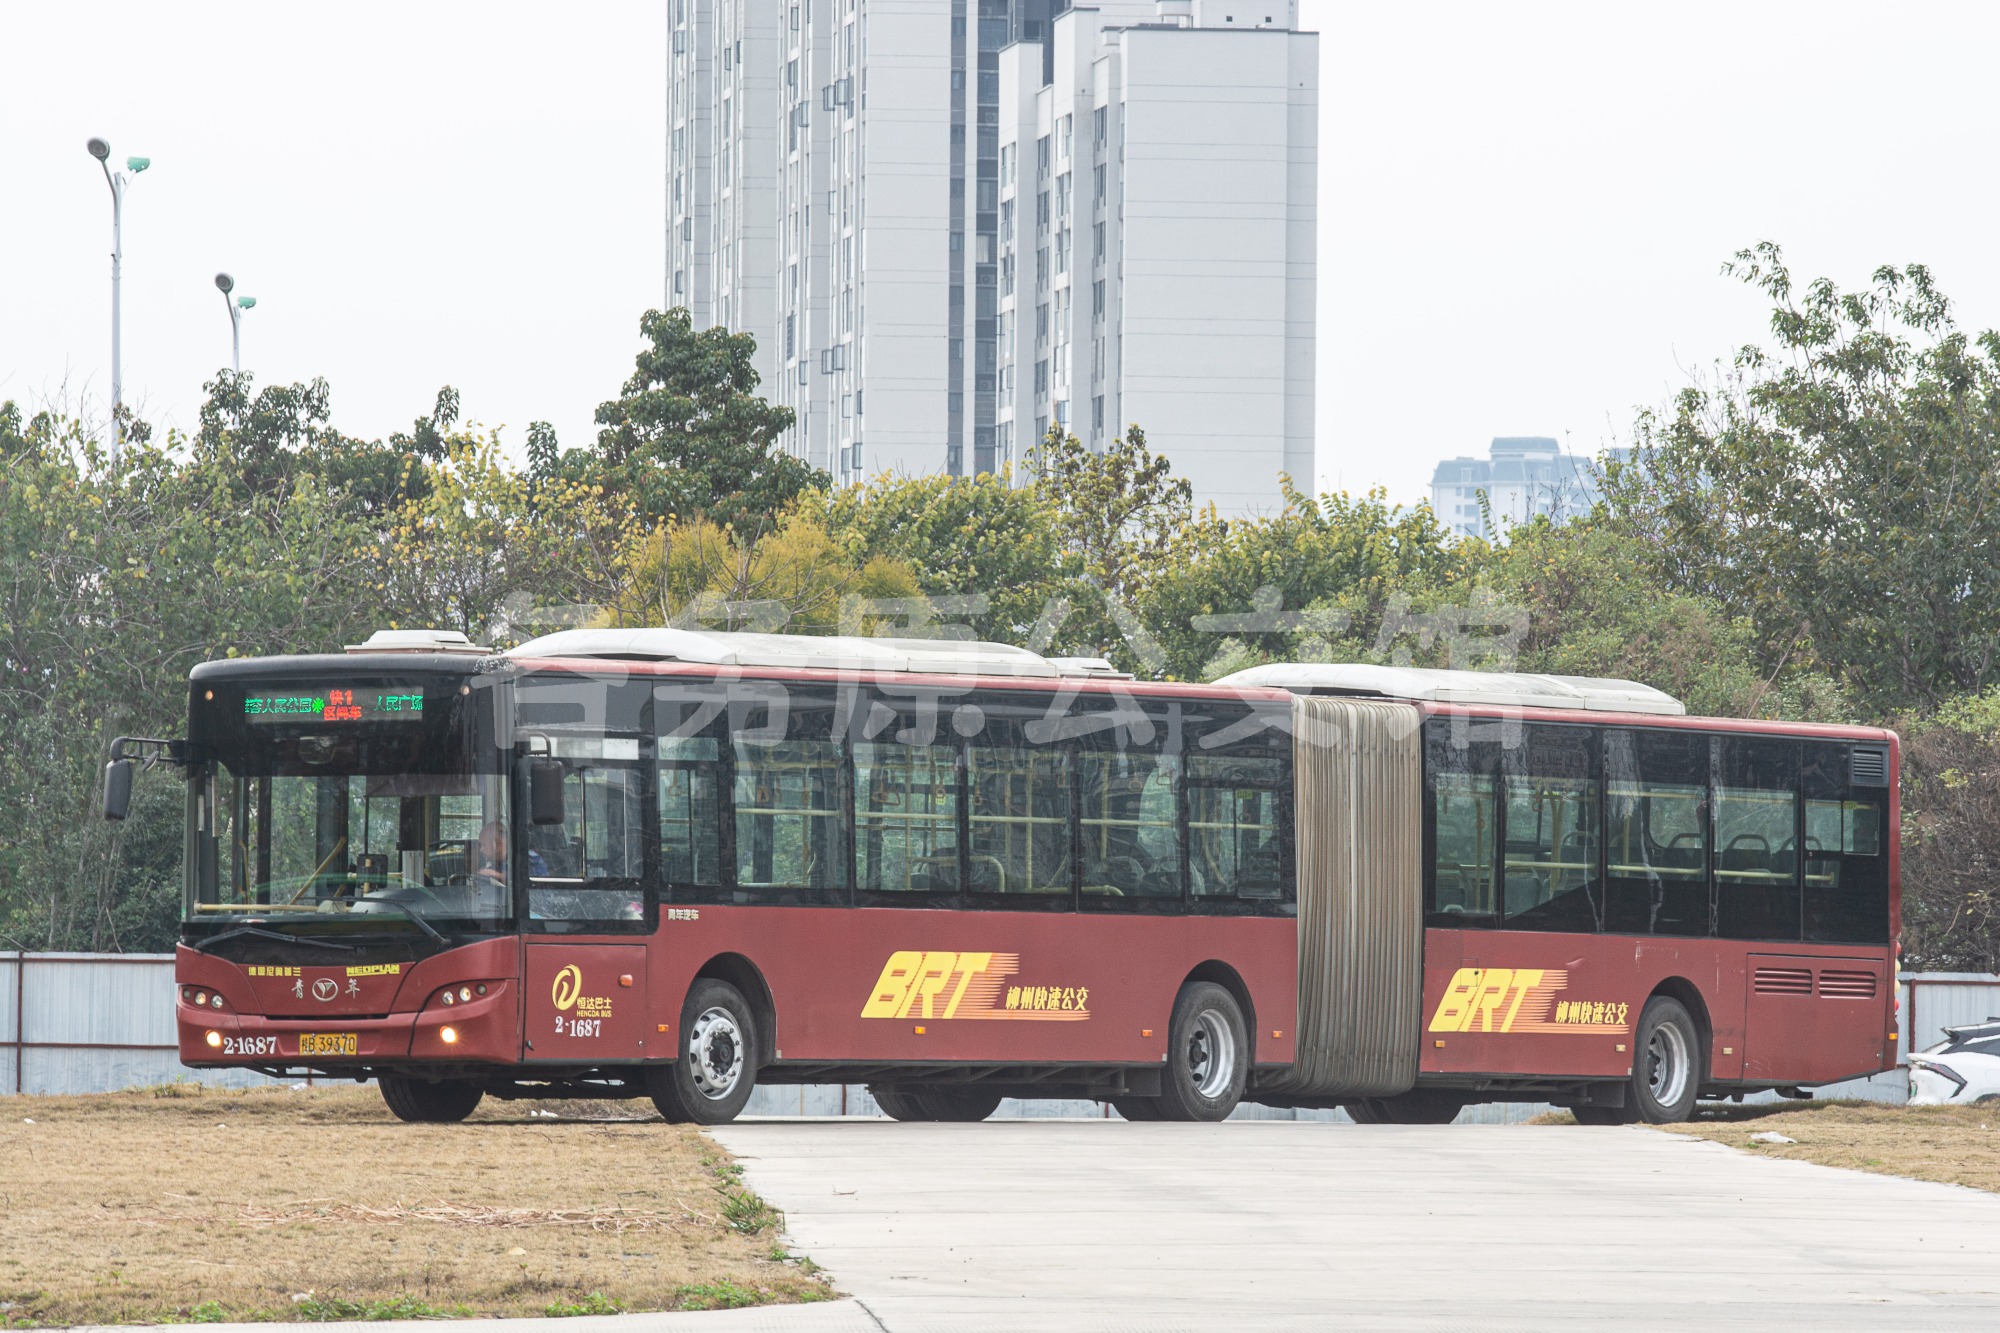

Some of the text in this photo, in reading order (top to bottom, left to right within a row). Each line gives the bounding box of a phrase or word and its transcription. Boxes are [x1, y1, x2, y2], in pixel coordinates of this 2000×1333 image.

[330, 690, 353, 705] 快1
[374, 695, 423, 711] 人民广场
[324, 706, 362, 720] 区间车
[668, 909, 699, 920] 青年汽车
[346, 964, 400, 976] NEOPLAN
[860, 950, 993, 1019] BRT
[577, 997, 612, 1009] 恒达巴士
[1005, 986, 1090, 1011] 柳州快速公交
[1428, 967, 1545, 1033] BRT
[1555, 1000, 1630, 1025] 柳州快速公交
